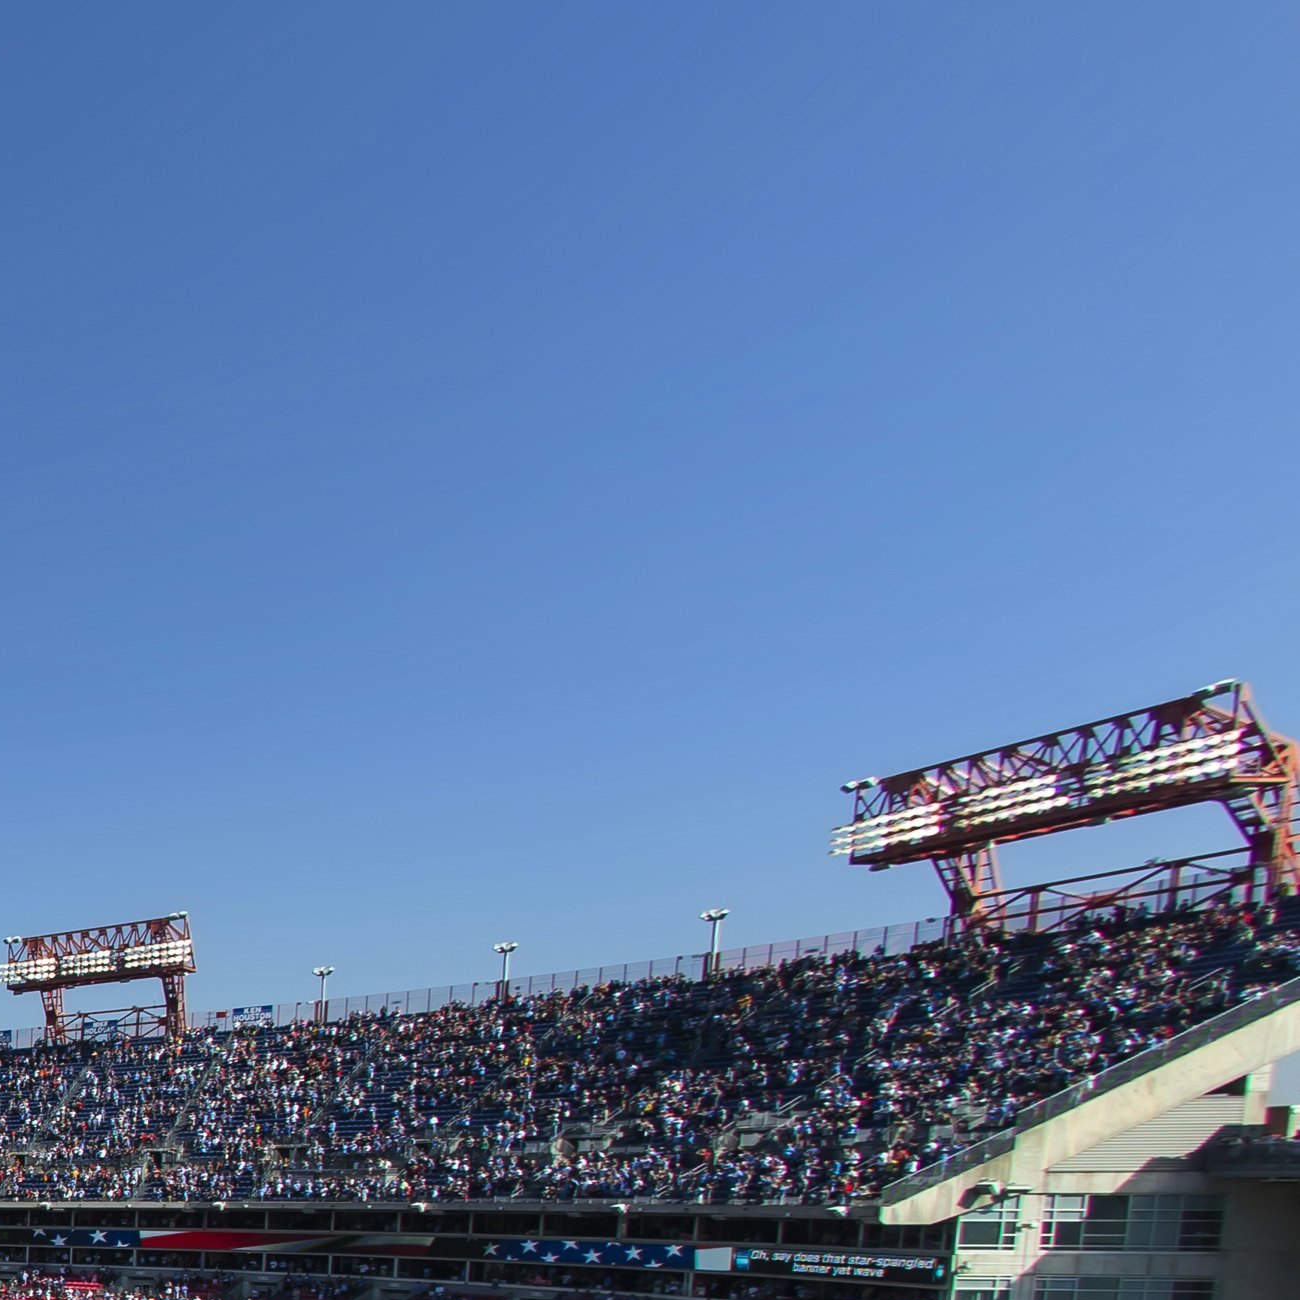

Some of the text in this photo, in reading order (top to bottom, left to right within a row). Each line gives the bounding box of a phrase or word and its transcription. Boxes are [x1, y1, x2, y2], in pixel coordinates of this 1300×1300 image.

[750, 1250, 935, 1270] Oh, say does that star-spangled
[792, 1262, 884, 1278] banner yet wave
